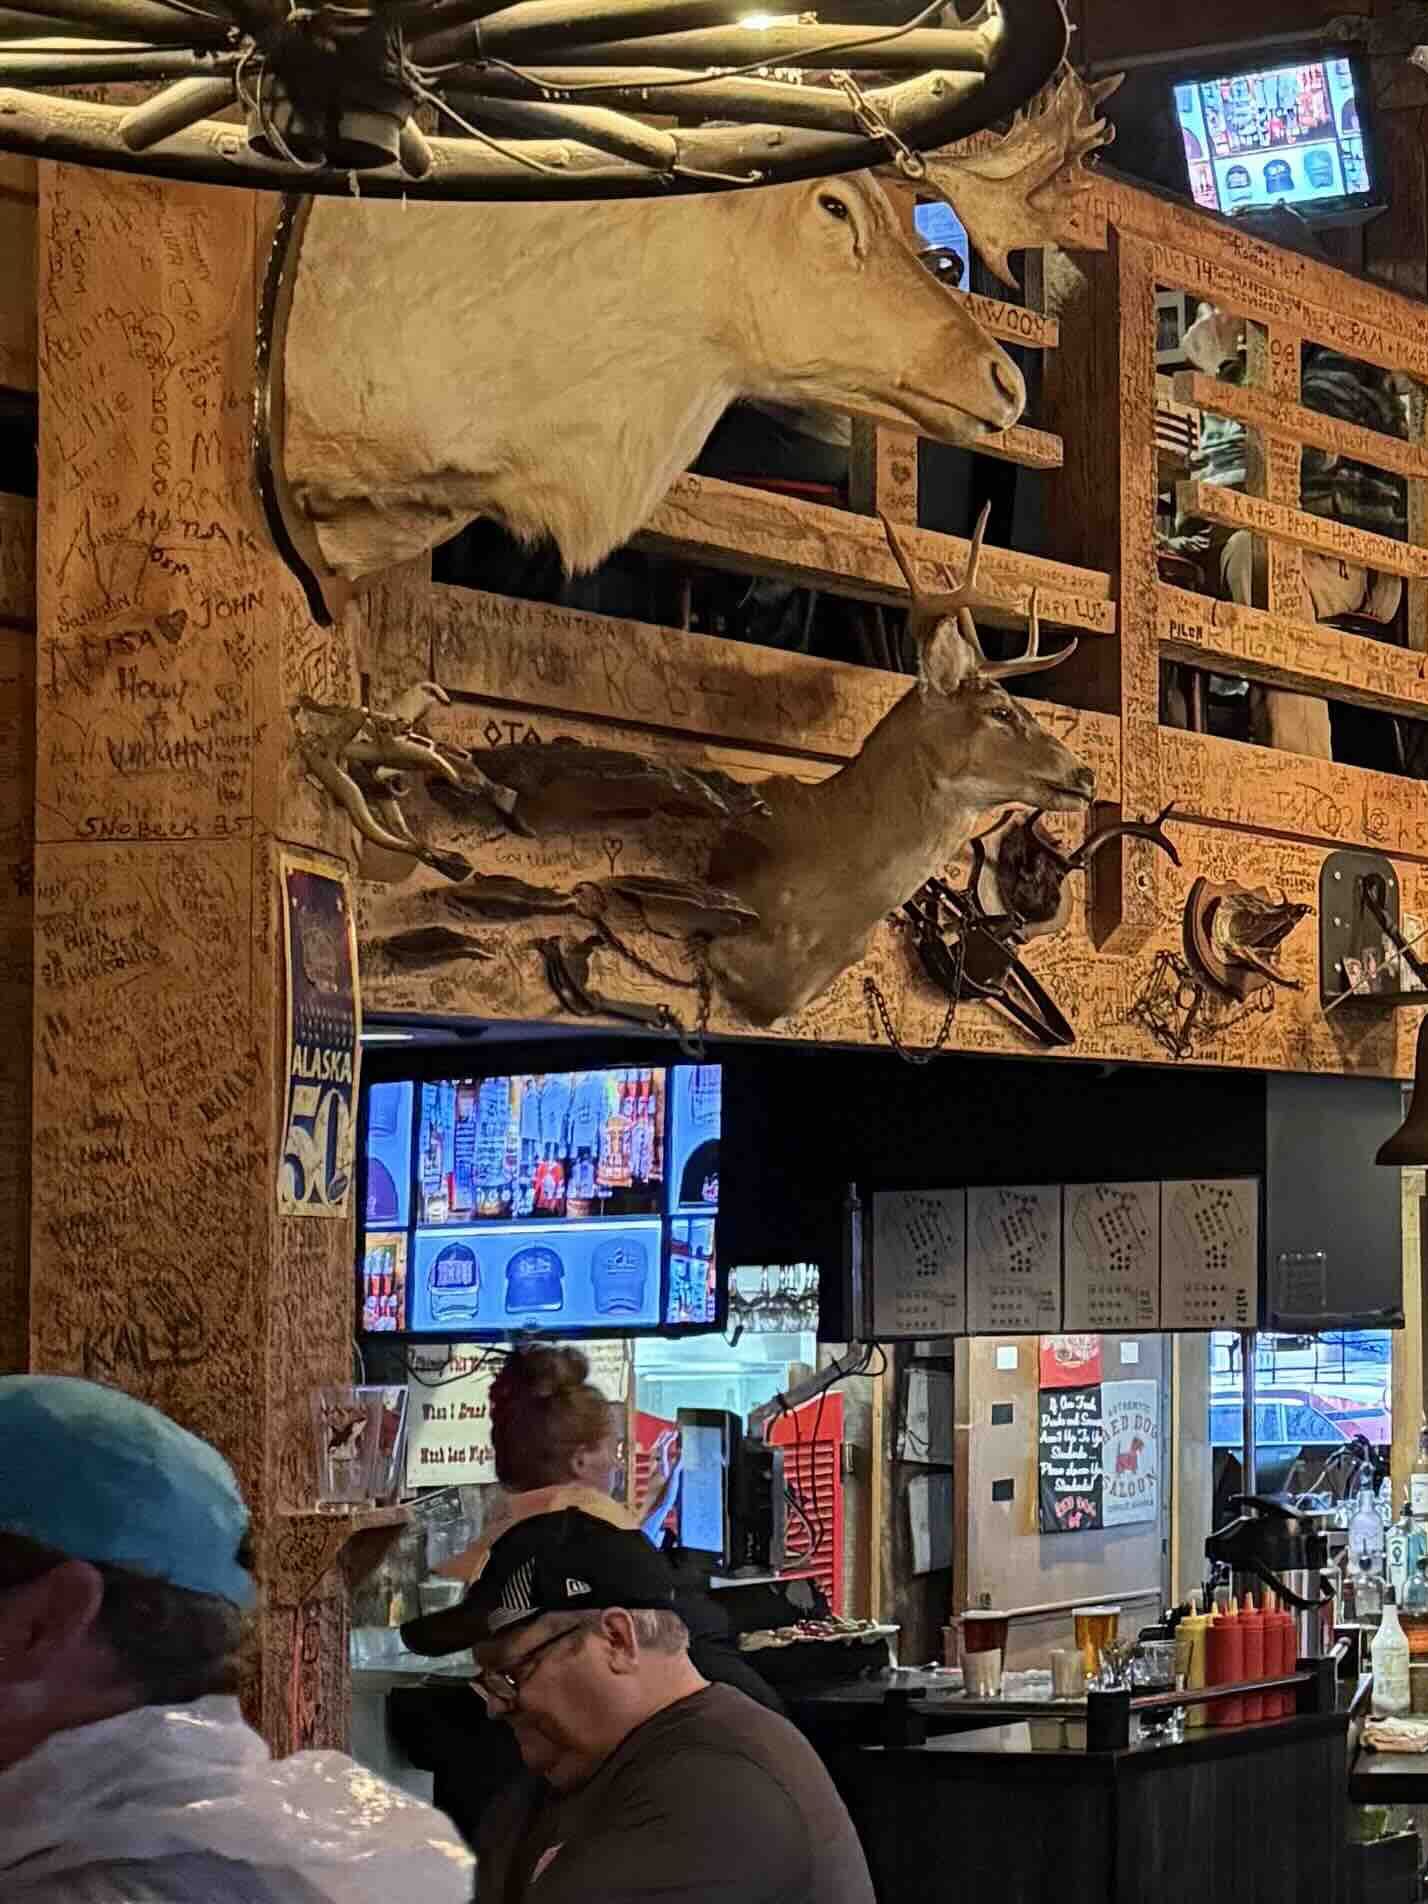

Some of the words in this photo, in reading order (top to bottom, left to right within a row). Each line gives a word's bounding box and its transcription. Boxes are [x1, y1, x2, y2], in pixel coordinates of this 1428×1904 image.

[198, 591, 265, 630] JOHN
[292, 1044, 353, 1085] ALASKA
[278, 1085, 352, 1207] 50
